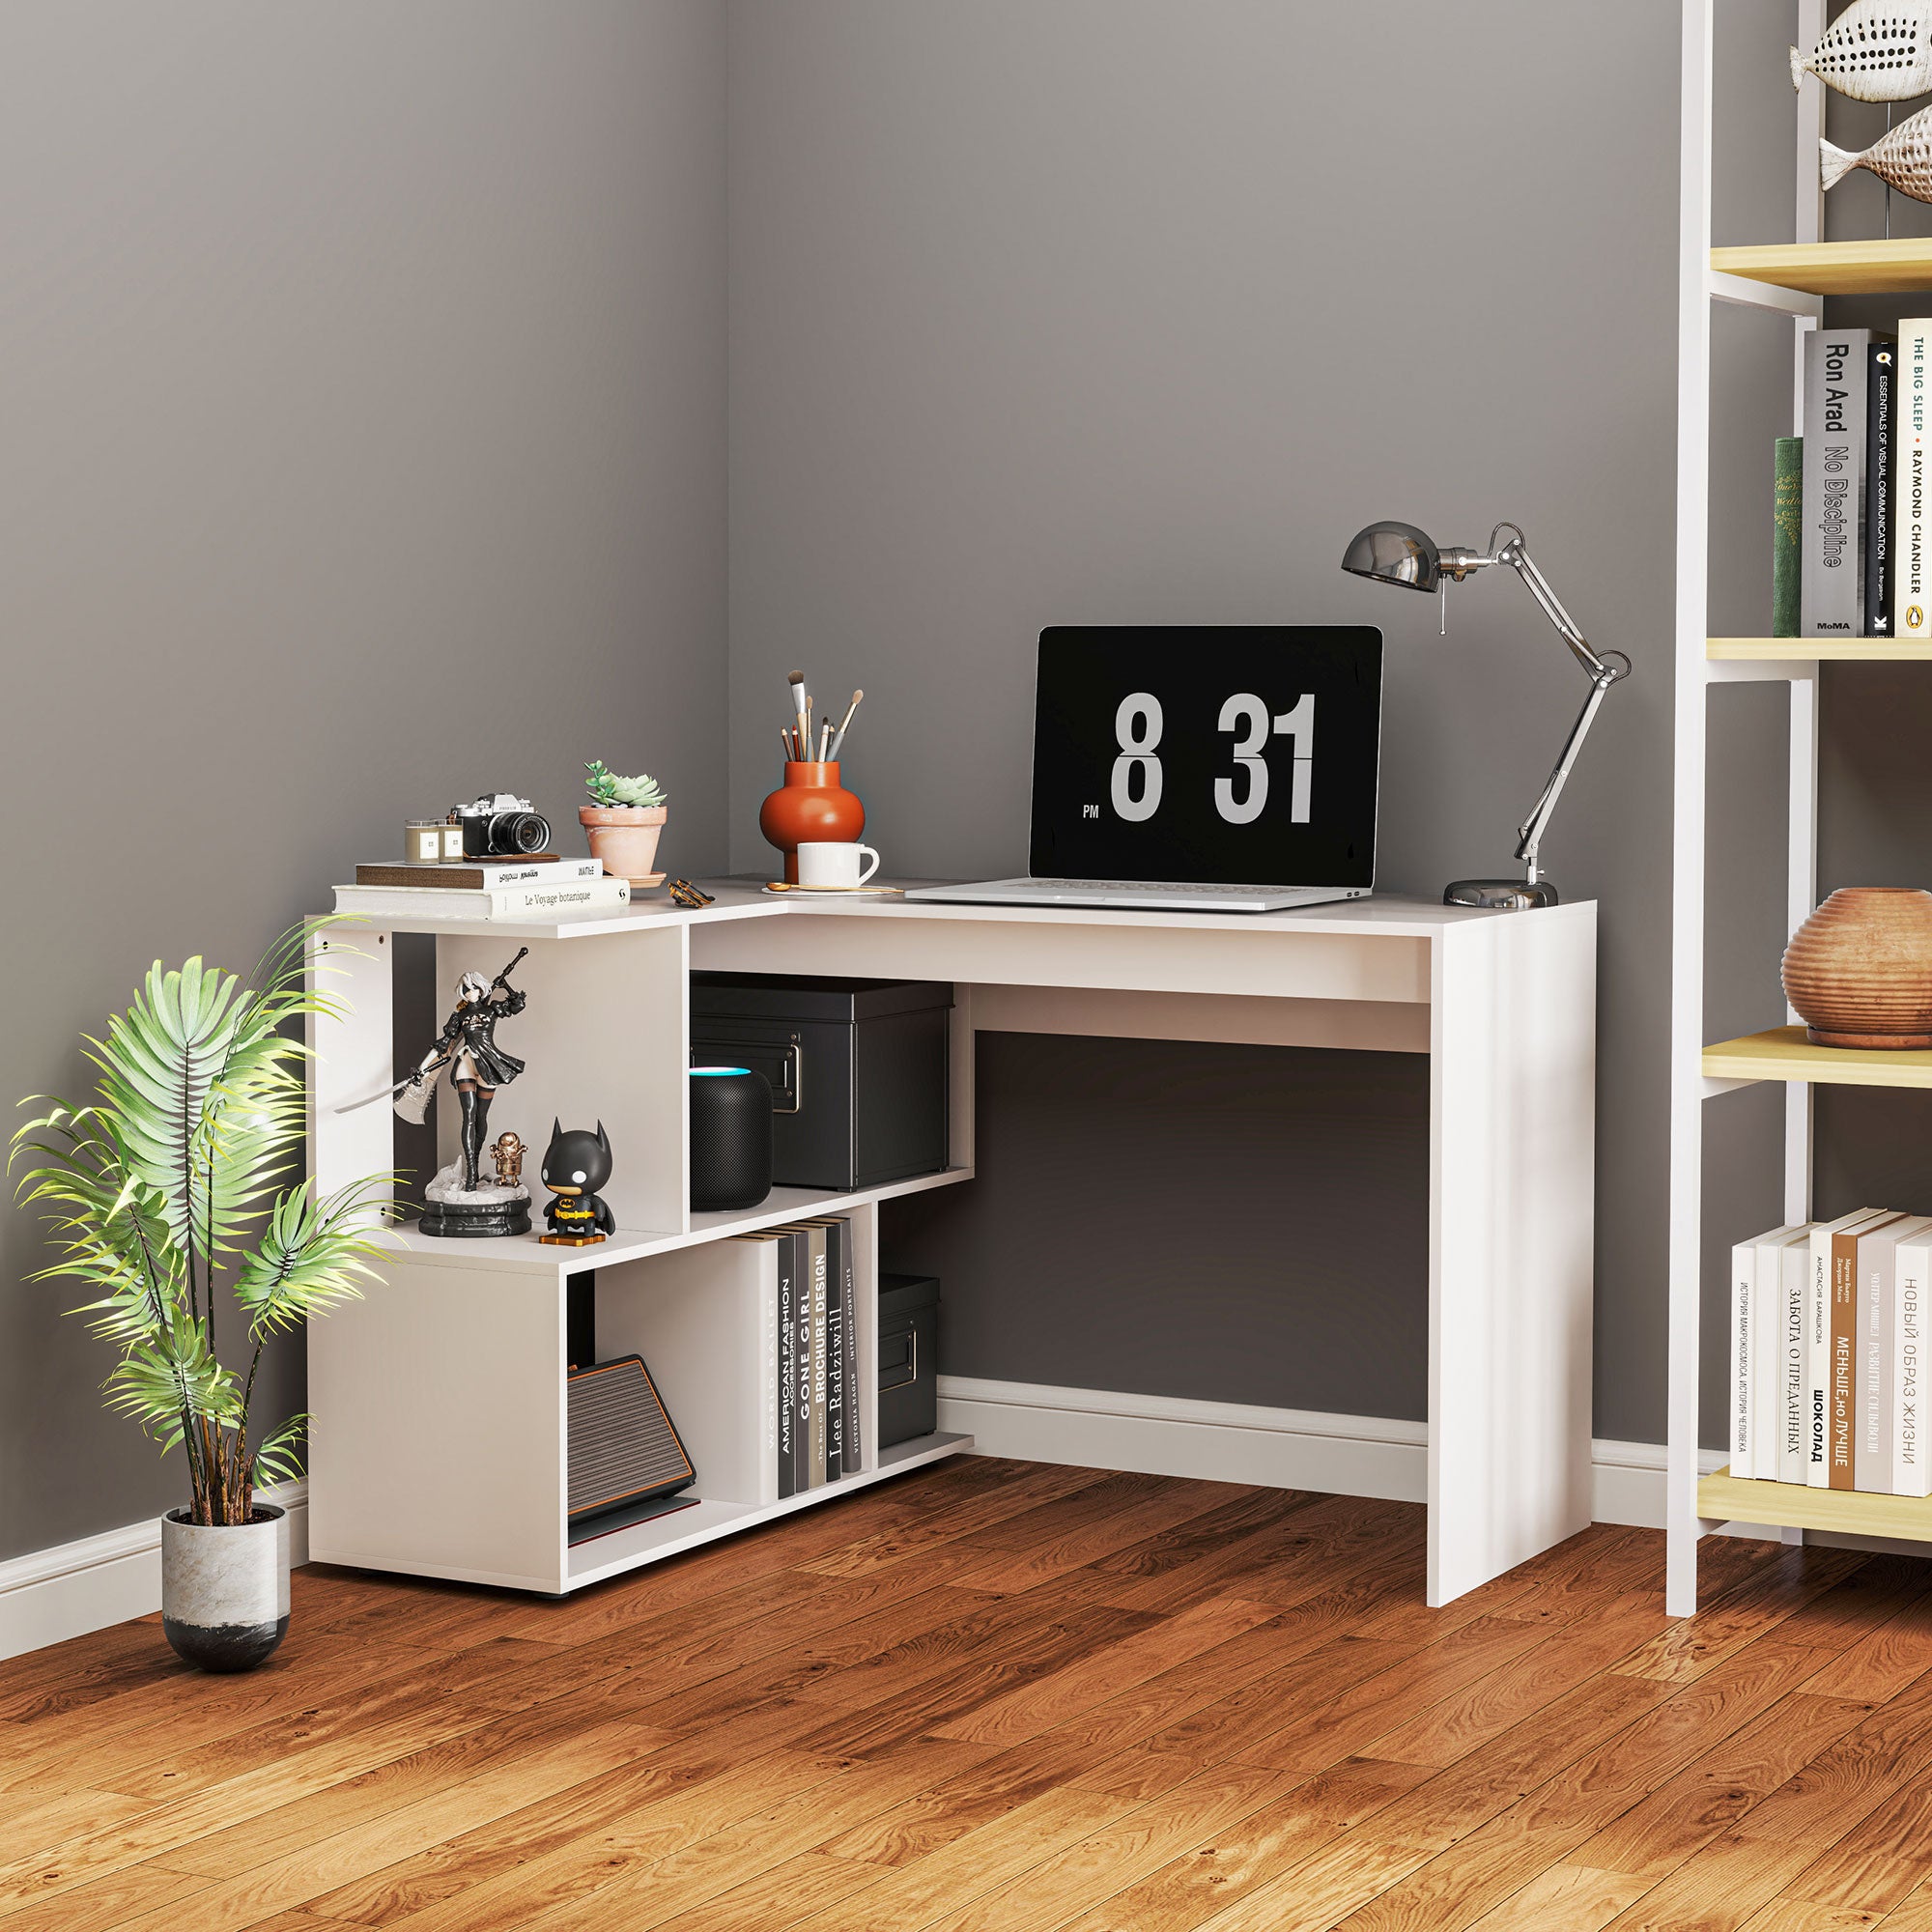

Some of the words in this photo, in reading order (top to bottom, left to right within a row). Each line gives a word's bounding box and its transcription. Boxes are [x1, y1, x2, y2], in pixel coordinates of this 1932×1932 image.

[1826, 344, 1849, 382] Ron
[1914, 337, 1924, 360] THE
[1879, 375, 1888, 431] ESSENTIALS
[1913, 366, 1923, 389] BIG
[1825, 387, 1849, 432] Arad
[1913, 395, 1923, 431] SLEEP
[1824, 446, 1849, 472] No
[1878, 432, 1887, 445] OF
[1878, 446, 1887, 479] VISUAL
[1912, 450, 1922, 519] RAYMOND
[1819, 479, 1849, 568] Discipline
[1877, 480, 1887, 559] COMMUNICATION
[1910, 524, 1921, 594] CHANDLER
[1111, 692, 1163, 822] 8
[1214, 693, 1315, 824] 31
[1083, 805, 1099, 819] PM
[525, 895, 533, 906] Le
[534, 894, 557, 906] Voyage
[558, 891, 591, 904] botanique
[815, 1254, 825, 1312] DESIGN
[1739, 1282, 1748, 1315] ИСТОРИЯ
[1904, 1278, 1919, 1339] НОВЫЙ
[801, 1291, 810, 1343] GIRL
[1789, 1289, 1802, 1343] ЗАБОТА
[815, 1316, 825, 1404] BROCHURE
[829, 1308, 841, 1411] Radziwill
[1788, 1348, 1801, 1359] О
[1868, 1342, 1880, 1395] РАЗВИТИЕ
[1902, 1345, 1917, 1397] ОБРАЗ
[801, 1352, 810, 1420] GONE
[1739, 1380, 1747, 1414] ИСТОРИЯ
[1787, 1363, 1801, 1454] ПРЕДАННЫХ
[829, 1419, 841, 1458] Lee
[1738, 1415, 1747, 1453] ЧЕЛОВЕКА
[1810, 1389, 1824, 1463] ШОКОЛАД
[1834, 1418, 1849, 1467] ЛУЧШЕ
[1902, 1402, 1916, 1464] ЖИЗНИ
